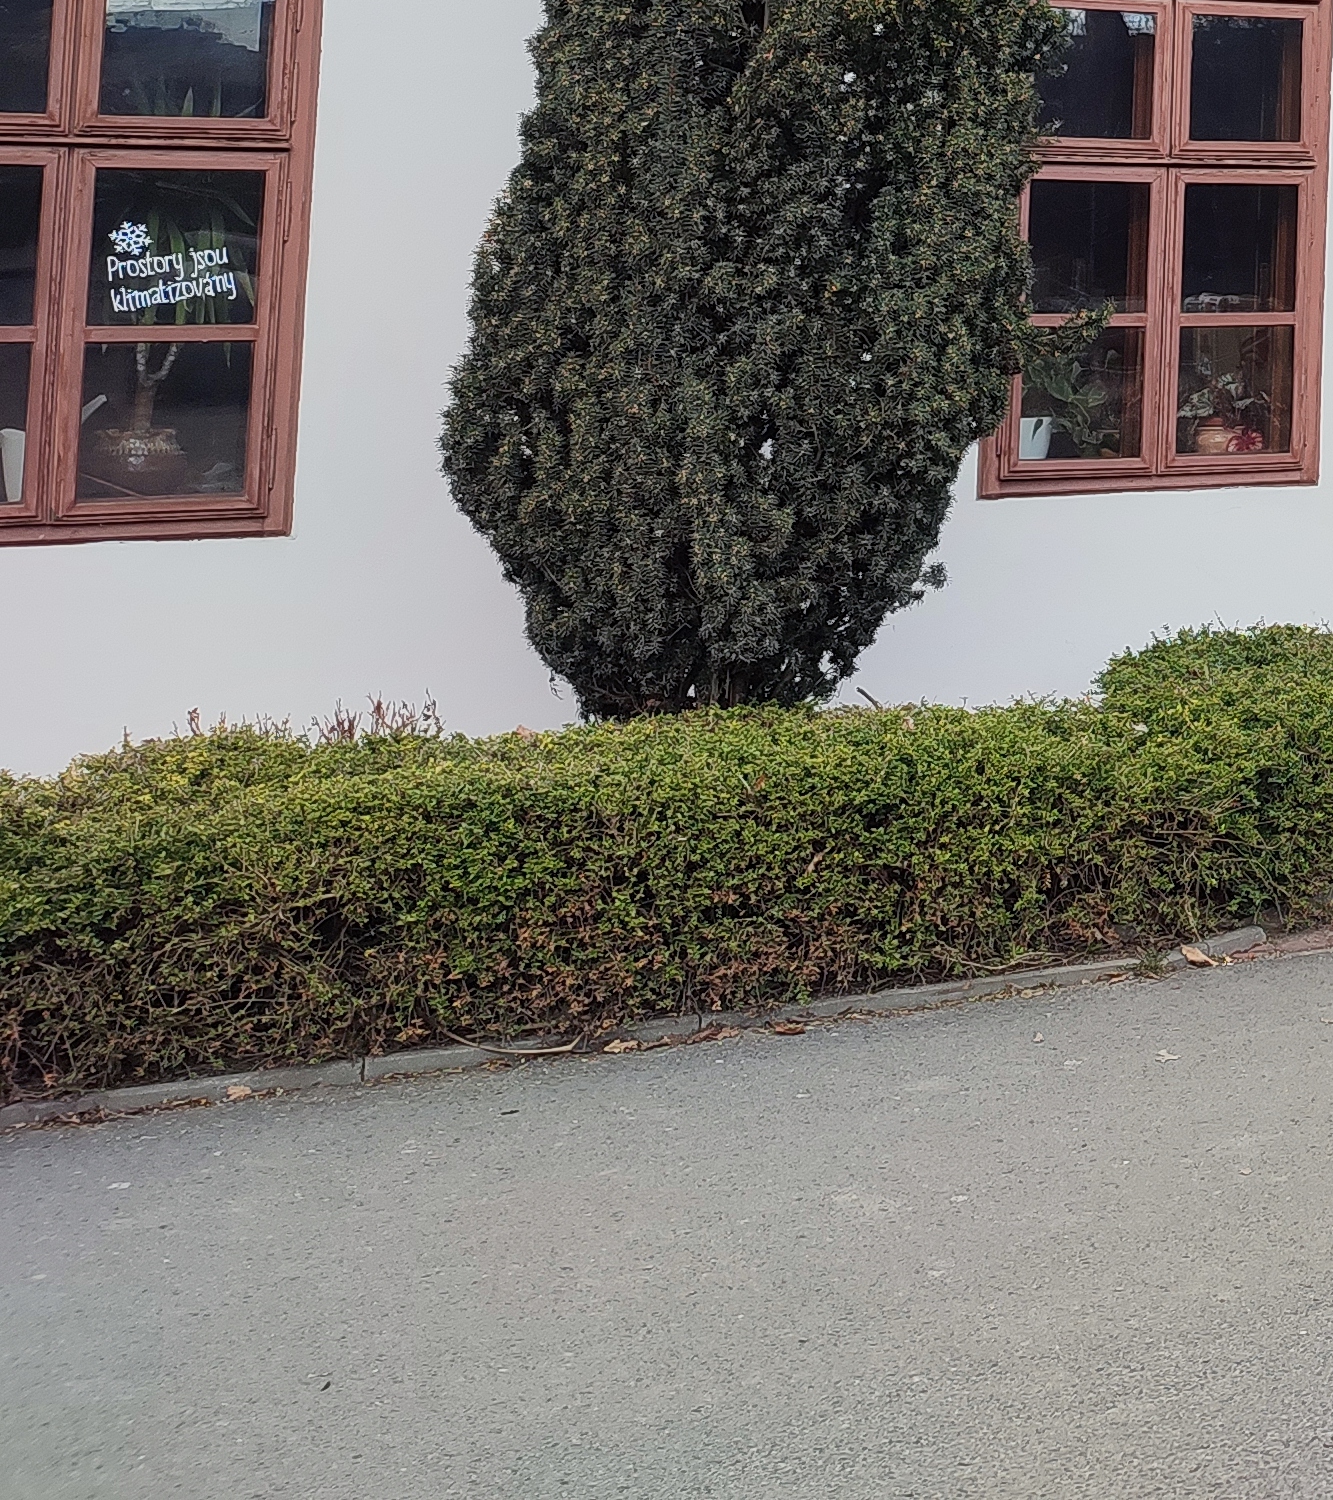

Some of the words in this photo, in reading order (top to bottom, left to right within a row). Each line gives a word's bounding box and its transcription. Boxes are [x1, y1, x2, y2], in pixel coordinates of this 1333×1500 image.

[106, 250, 184, 282] Prostory
[188, 245, 229, 277] jsou
[110, 270, 237, 312] klimatizovány
